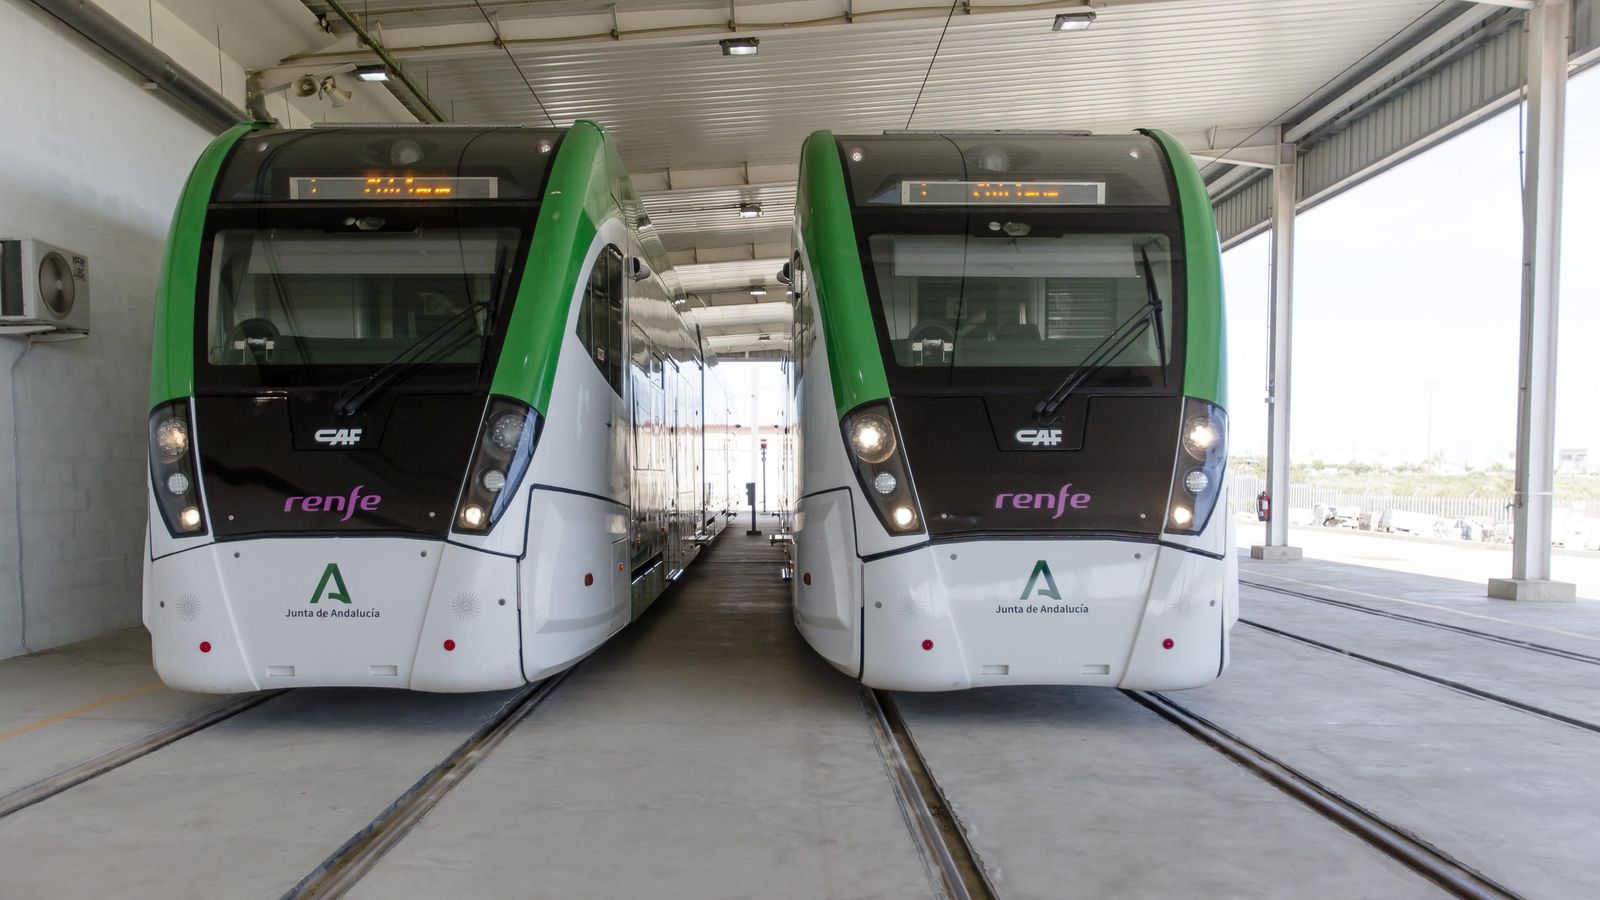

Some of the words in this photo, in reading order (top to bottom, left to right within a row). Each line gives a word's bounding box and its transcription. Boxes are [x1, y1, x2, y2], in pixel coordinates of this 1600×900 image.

[314, 429, 362, 445] CAF
[1016, 430, 1062, 445] CAF
[284, 485, 382, 521] renfe
[995, 483, 1091, 519] renfe
[285, 608, 314, 618] Junta
[316, 608, 329, 618] de
[331, 607, 380, 618] Andalucía
[996, 604, 1024, 614] Junta
[1026, 604, 1039, 614] de
[1040, 603, 1089, 614] Andalucía
